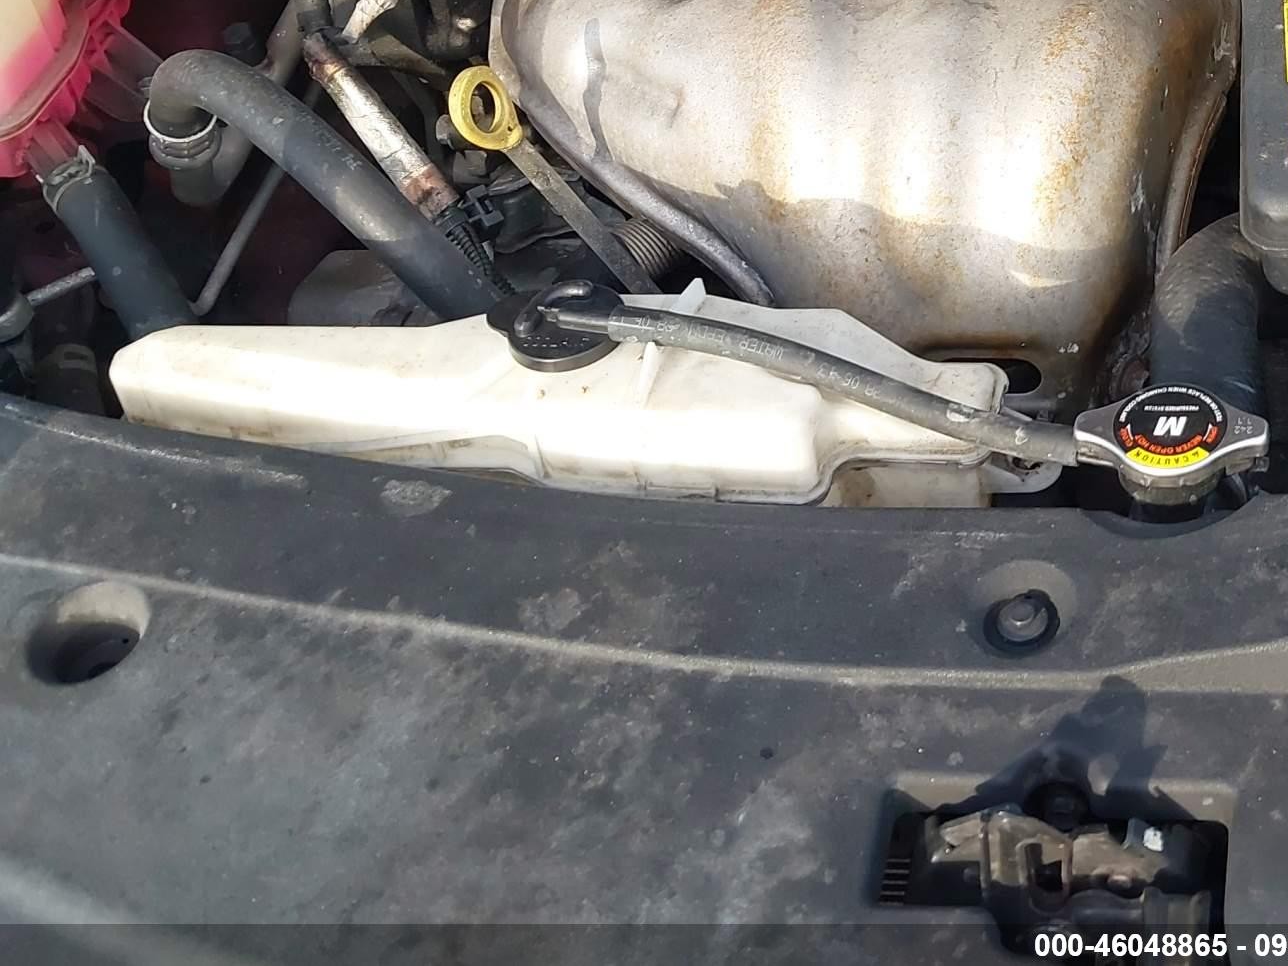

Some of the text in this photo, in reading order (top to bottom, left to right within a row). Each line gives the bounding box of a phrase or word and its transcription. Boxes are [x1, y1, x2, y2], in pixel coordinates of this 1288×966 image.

[739, 339, 785, 361] WATER
[1152, 416, 1187, 436] M
[1134, 434, 1150, 450] HOT
[1149, 443, 1174, 454] OPEN
[1133, 450, 1190, 465] CAUTION
